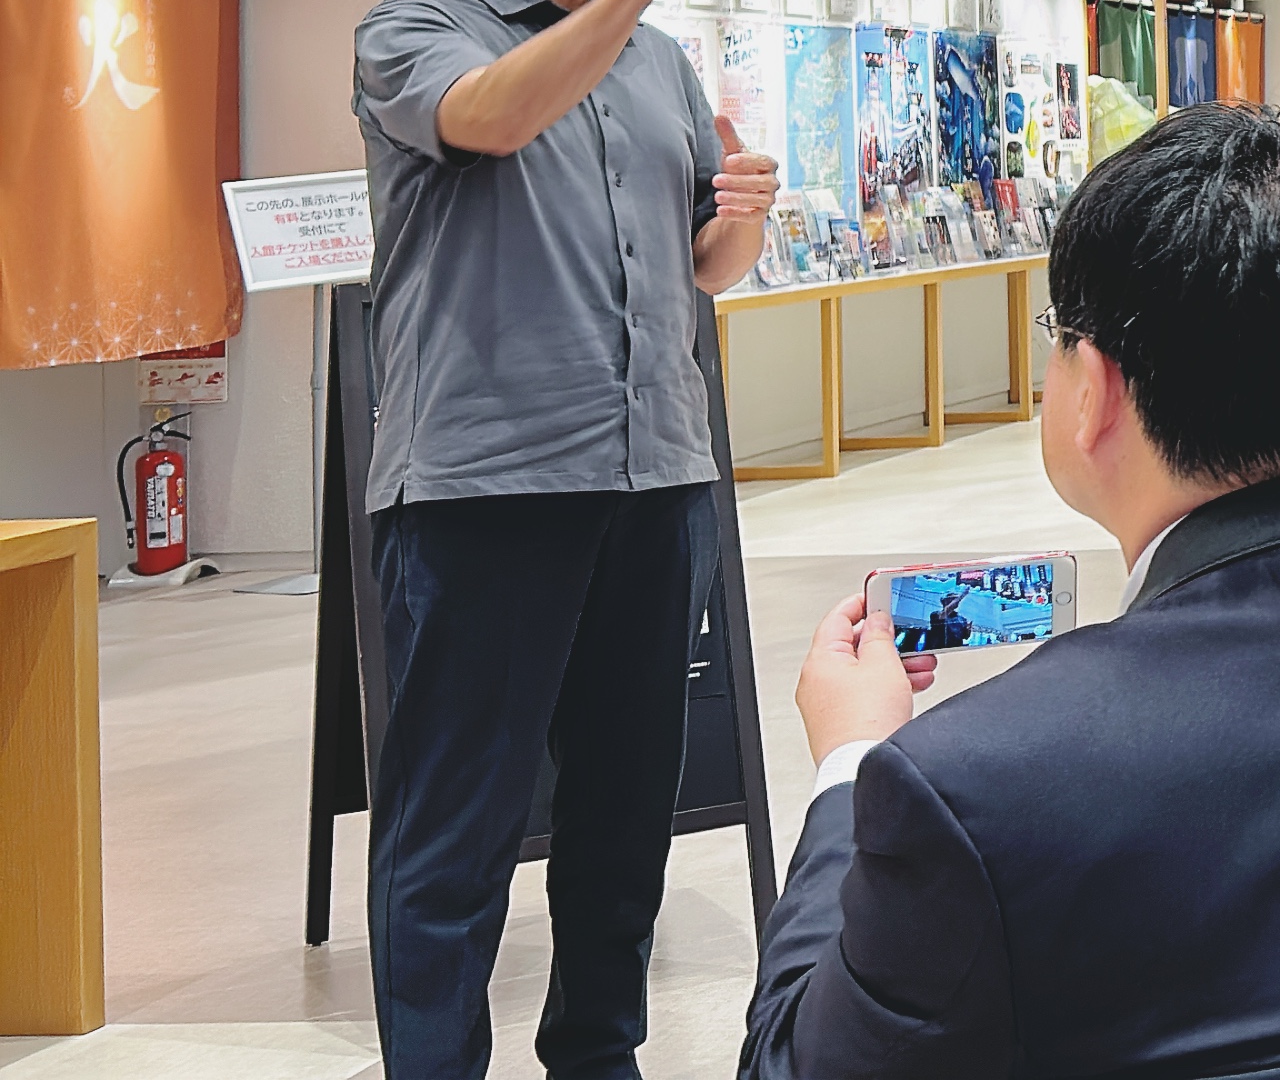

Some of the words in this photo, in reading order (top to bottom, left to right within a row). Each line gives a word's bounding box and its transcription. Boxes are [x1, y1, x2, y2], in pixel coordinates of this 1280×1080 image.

[274, 206, 364, 225] 有料となります。
[298, 222, 347, 238] 受付にて
